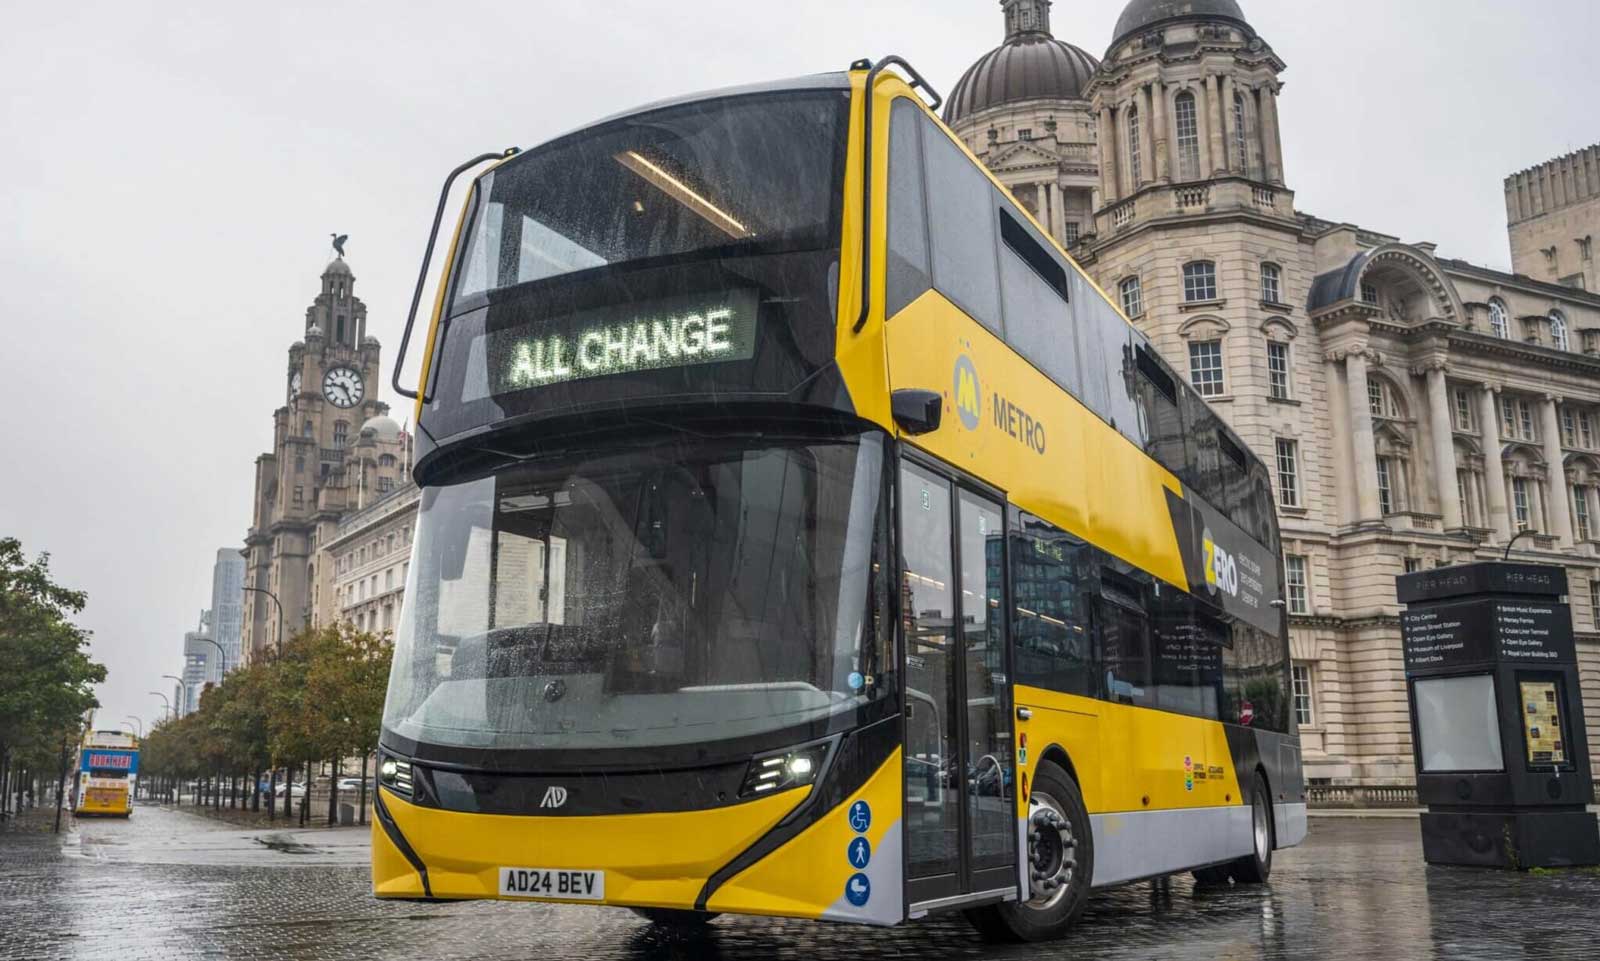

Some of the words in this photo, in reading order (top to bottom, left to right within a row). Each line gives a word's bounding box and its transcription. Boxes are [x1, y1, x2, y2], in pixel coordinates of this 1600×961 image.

[511, 336, 570, 384] ALL
[579, 307, 734, 371] CHANGE
[993, 391, 1046, 456] METRO
[1203, 537, 1238, 598] ZERO
[1506, 572, 1525, 583] PIER
[1527, 575, 1551, 585] HEAD
[1527, 639, 1543, 648] Gallery
[506, 869, 552, 893] AD24
[558, 872, 596, 895] BEV
